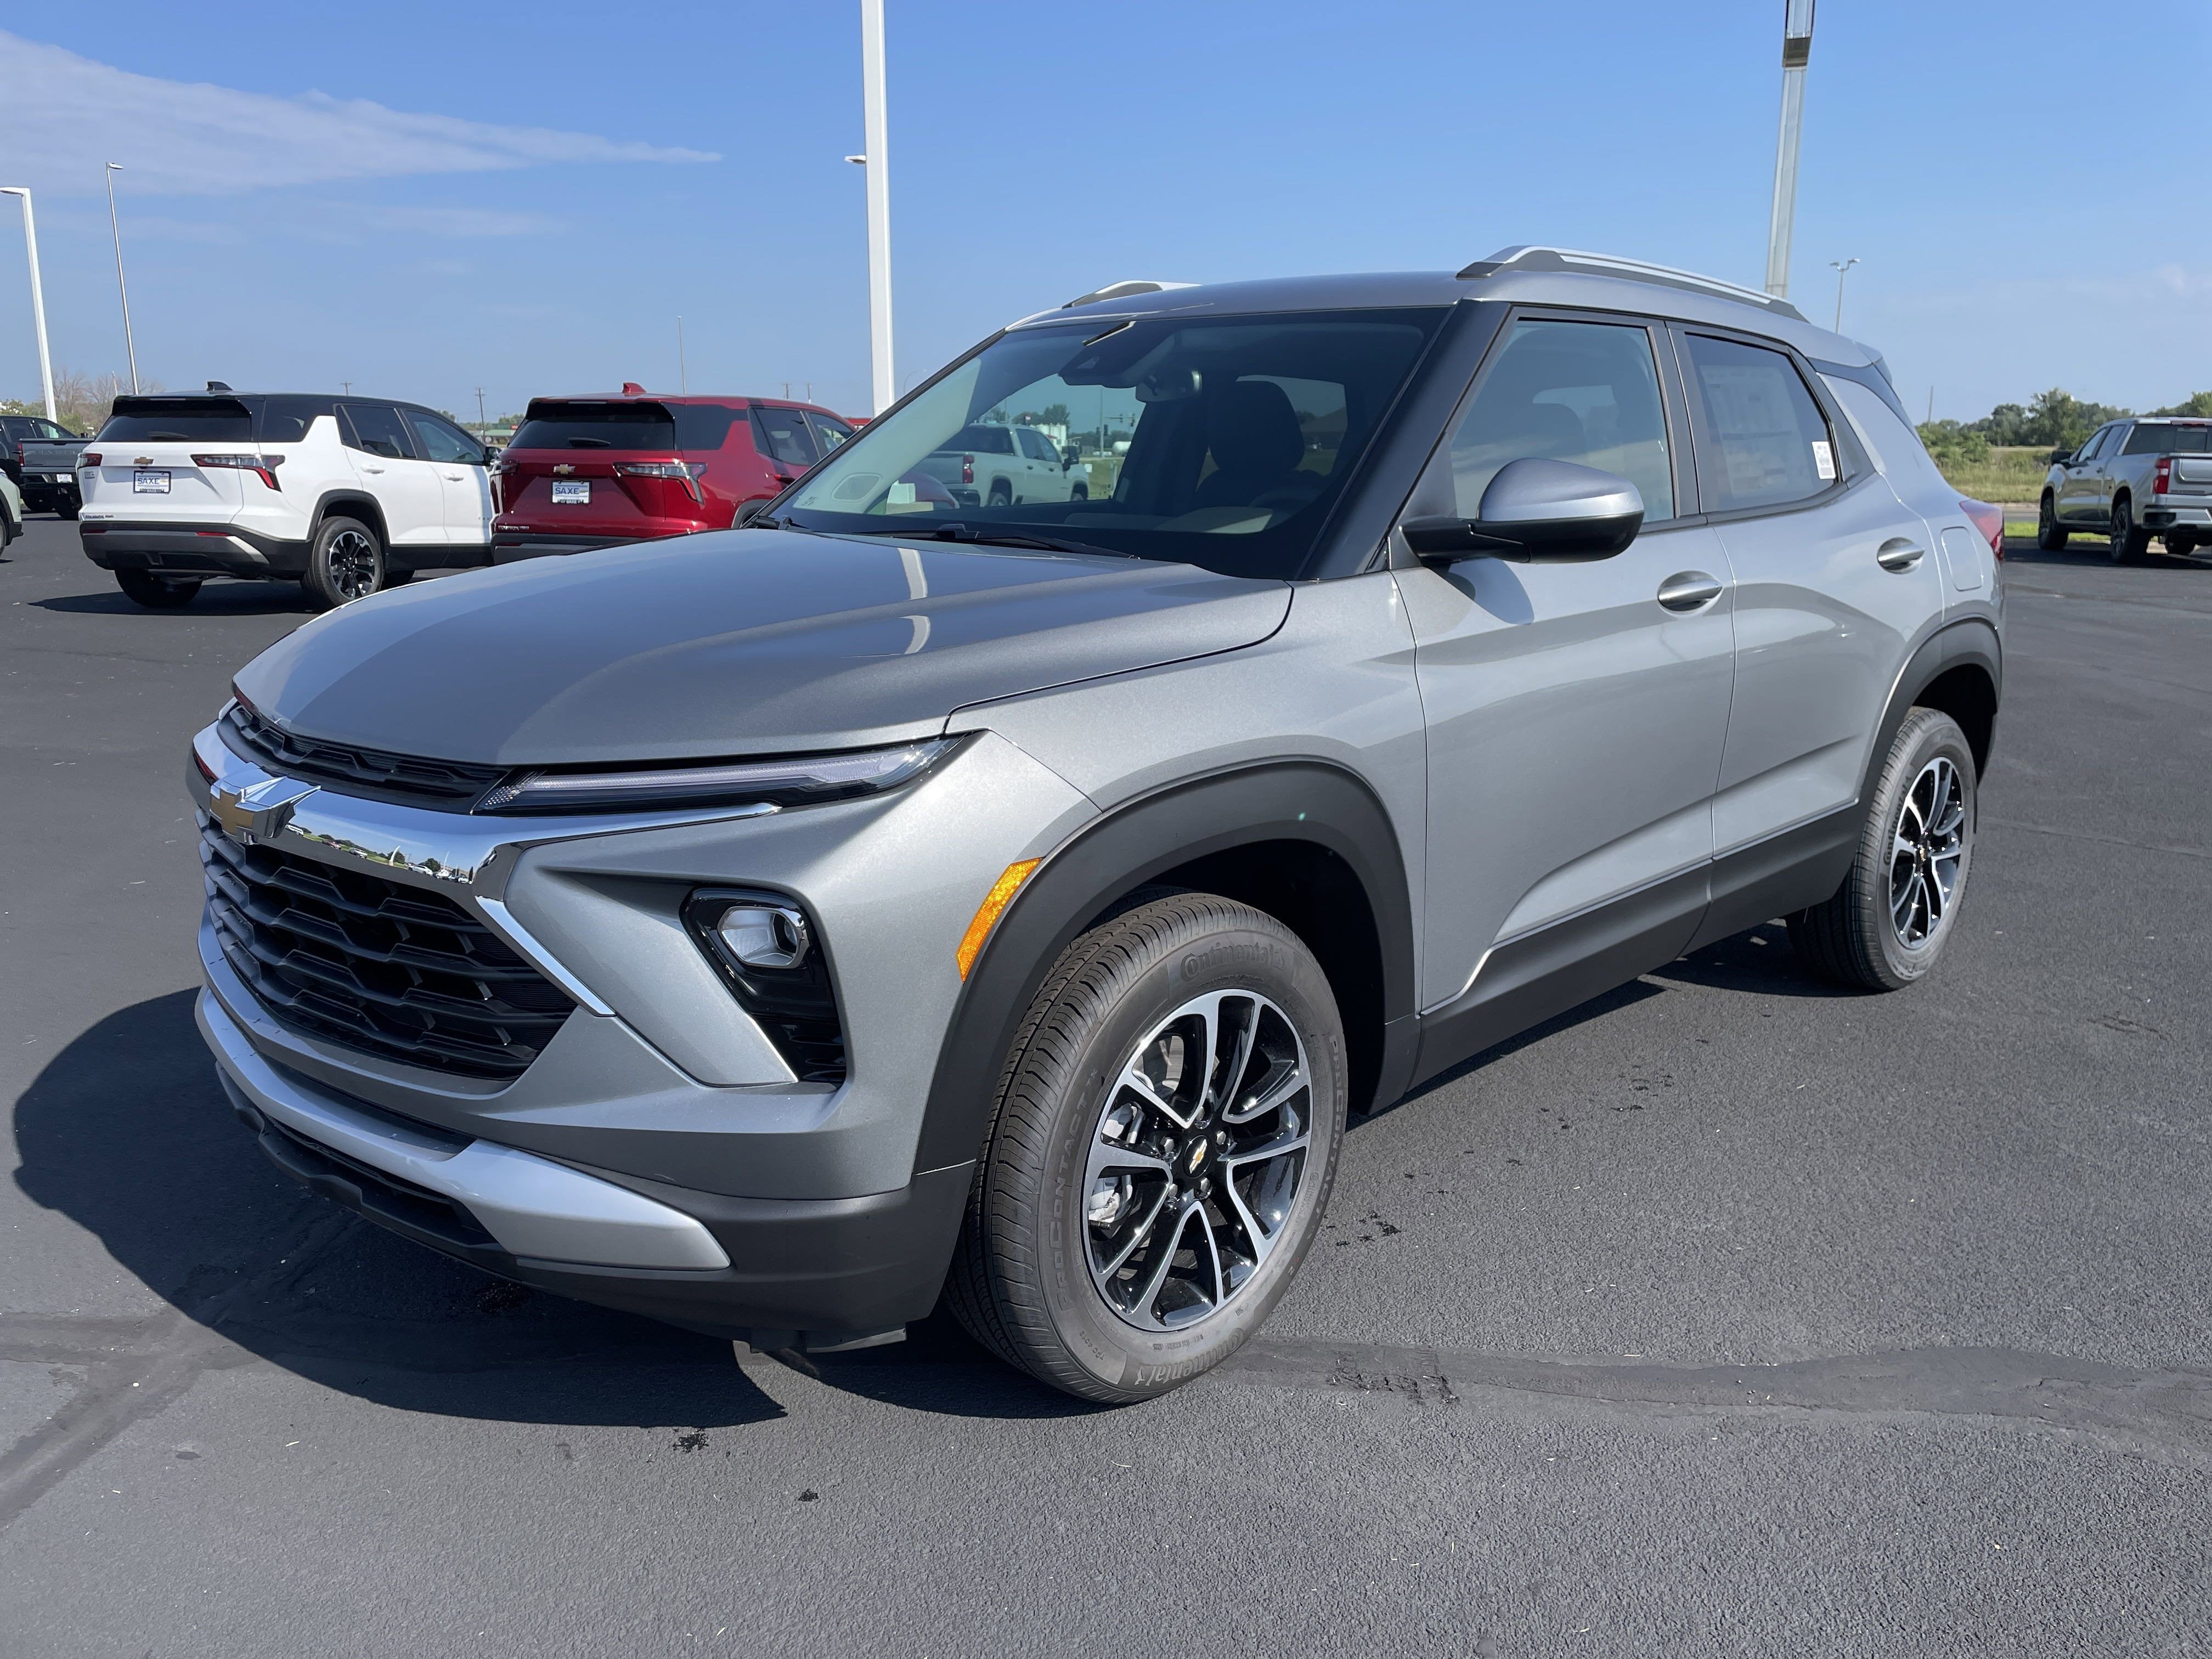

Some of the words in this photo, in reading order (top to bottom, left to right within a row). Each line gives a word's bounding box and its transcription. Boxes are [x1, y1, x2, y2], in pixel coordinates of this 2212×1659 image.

[555, 487, 579, 495] SAXE
[1181, 941, 1274, 983] Continental
[1049, 1092, 1089, 1312] PROCONTACT
[1145, 1328, 1245, 1386] Continental
